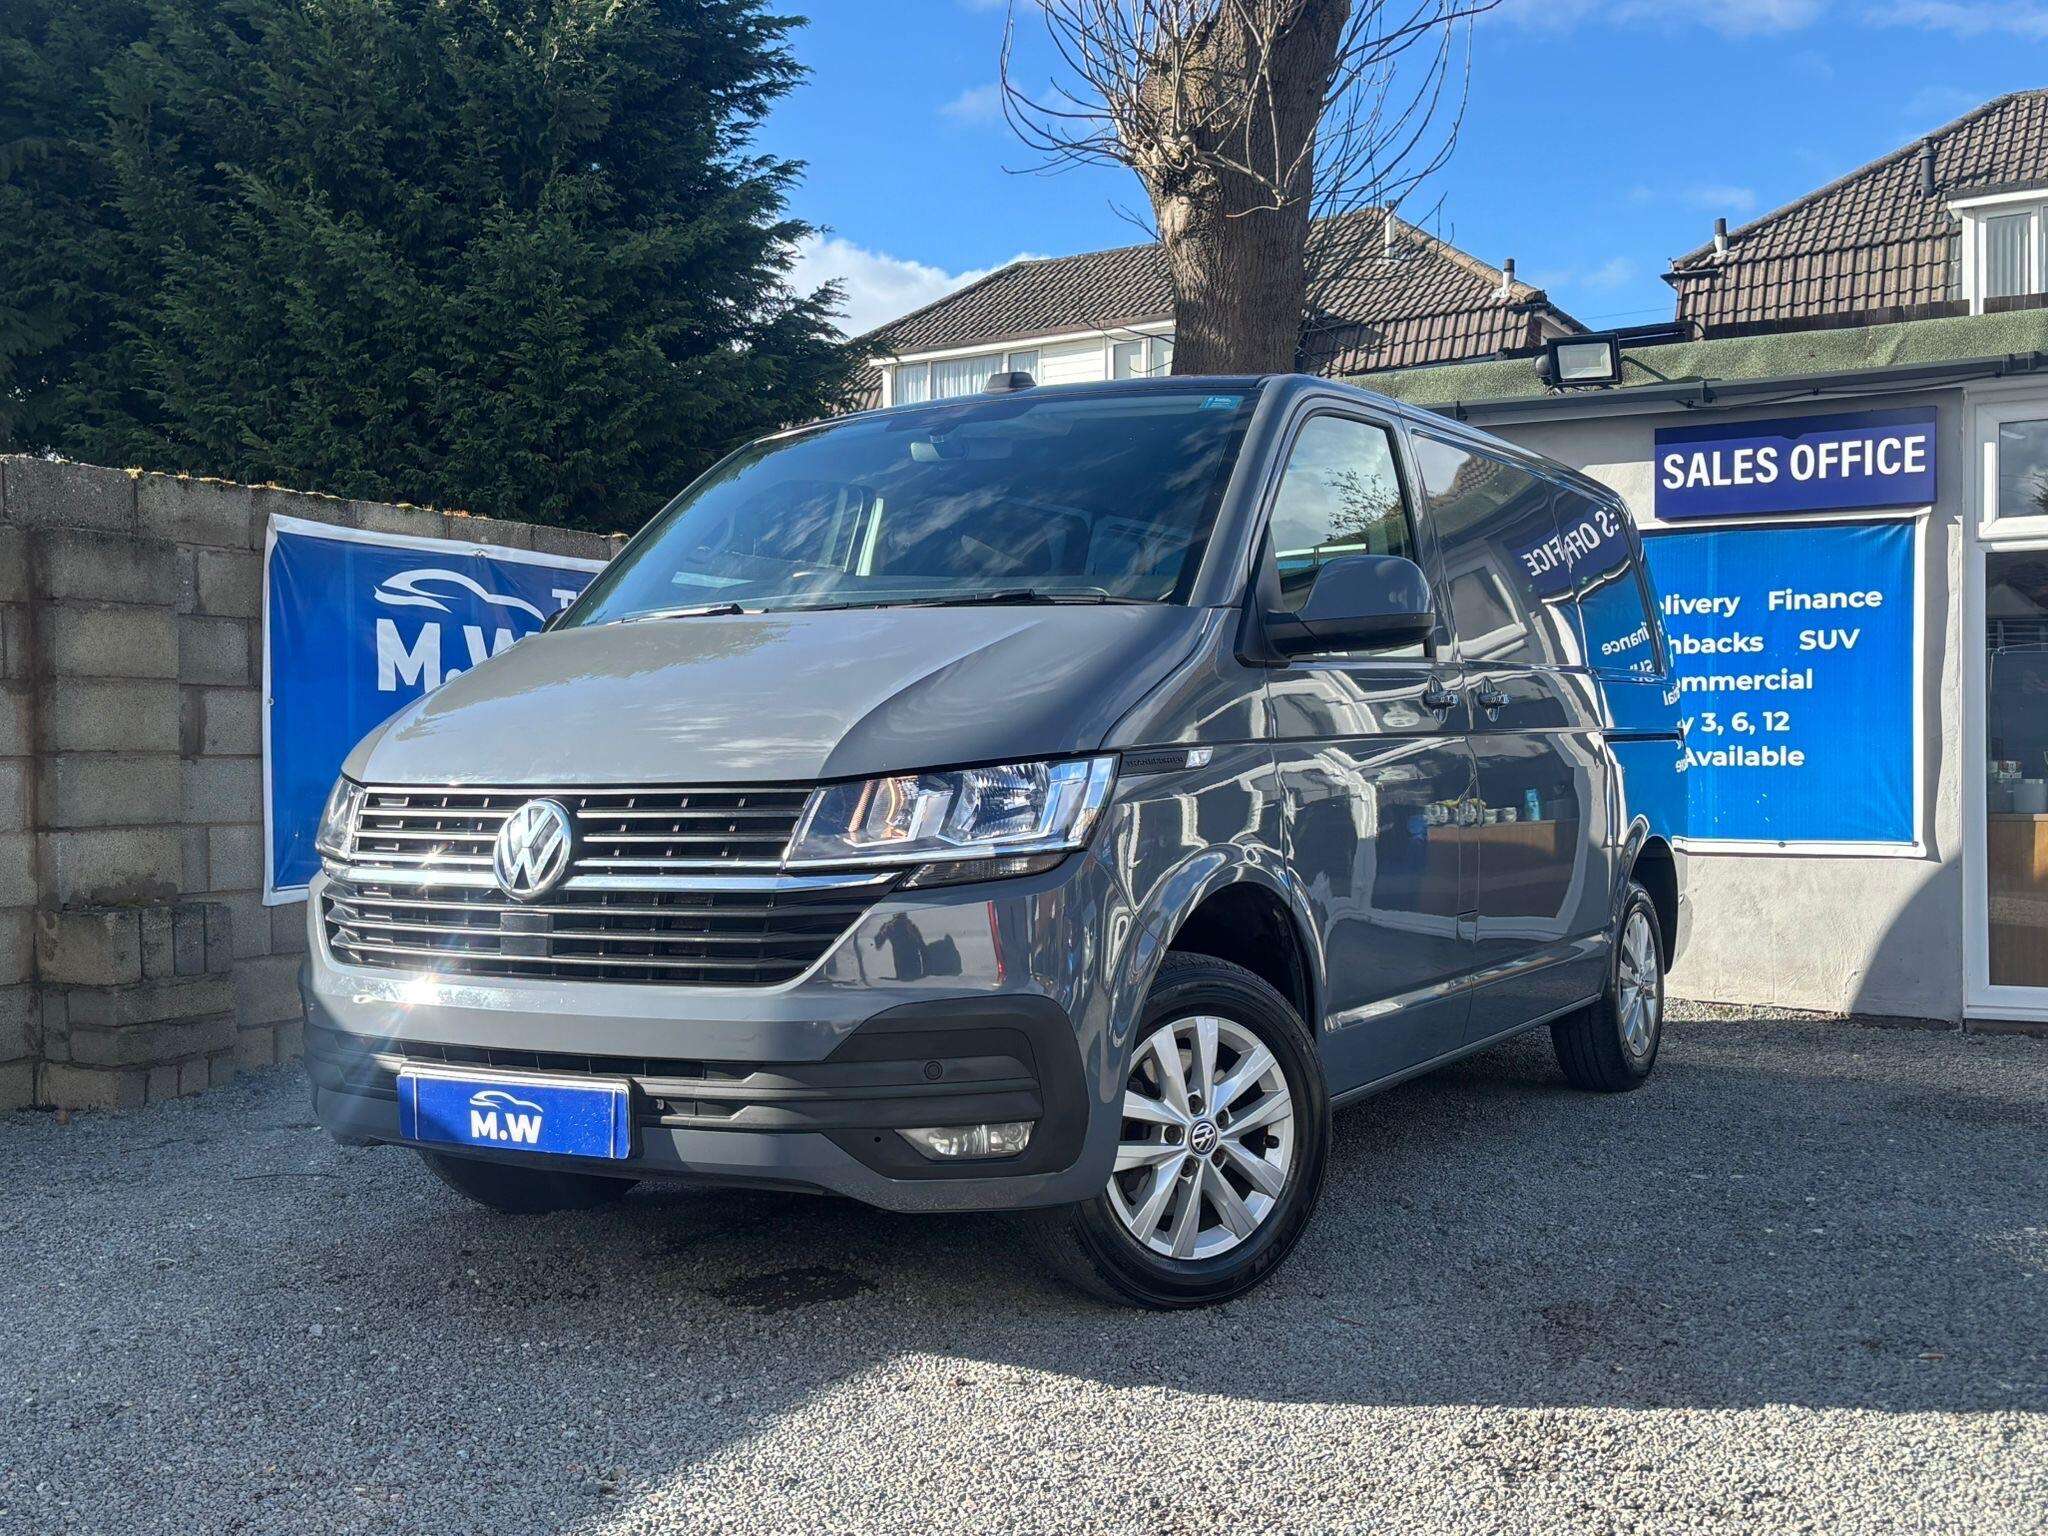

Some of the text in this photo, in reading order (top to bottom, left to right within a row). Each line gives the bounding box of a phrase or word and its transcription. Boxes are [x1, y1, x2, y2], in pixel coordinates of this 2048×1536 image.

[1662, 434, 1926, 490] SALES OFFICE
[1659, 593, 1741, 618] livery
[1768, 588, 1883, 612] Finance
[1798, 628, 1861, 652] SUV
[1676, 668, 1814, 692] mmercial
[1700, 712, 1725, 736] 3,
[1731, 711, 1756, 735] 6,
[1762, 711, 1791, 732] 12
[1684, 744, 1805, 767] Available
[470, 1110, 543, 1143] M.W
